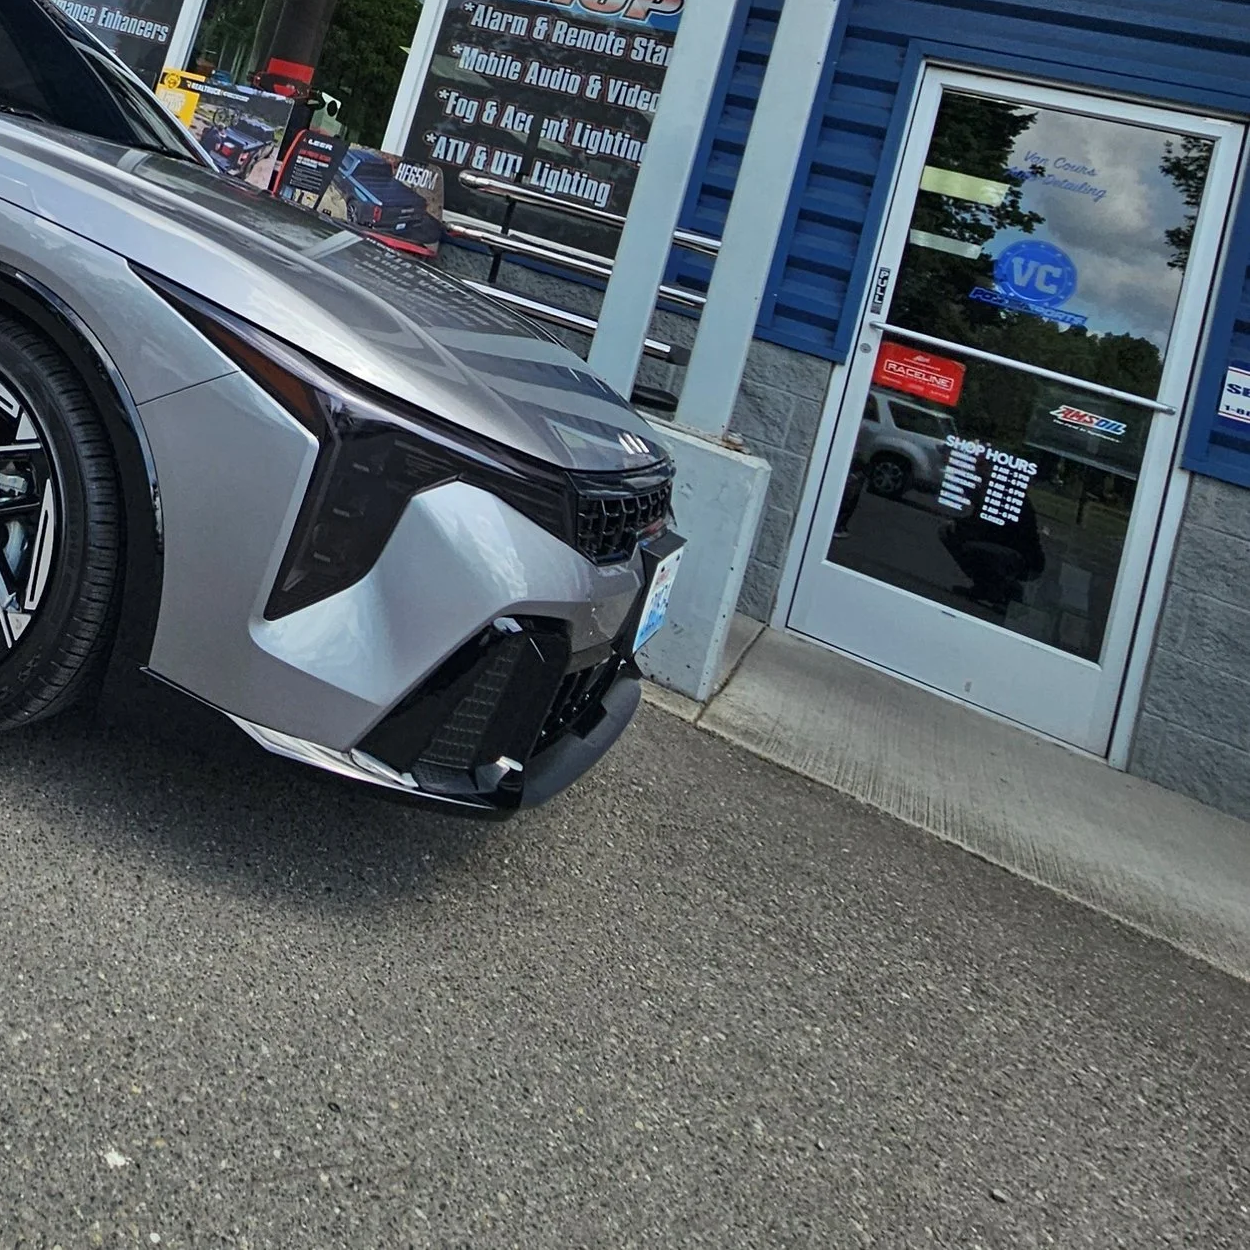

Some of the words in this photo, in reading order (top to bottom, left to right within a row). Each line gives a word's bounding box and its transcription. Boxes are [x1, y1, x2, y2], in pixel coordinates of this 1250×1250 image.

[98, 6, 170, 42] Enhancers
[532, 15, 548, 41] &
[551, 19, 627, 57] Remote
[524, 61, 582, 96] Audio
[585, 72, 602, 100] &
[607, 78, 661, 113] Video
[481, 100, 498, 126] &
[307, 138, 334, 151] LEER
[394, 162, 439, 191] HF650M
[471, 146, 488, 171] &
[530, 160, 612, 208] Lighting
[1023, 150, 1050, 165] Van
[1053, 156, 1099, 178] Cours
[1041, 174, 1107, 203] Detailing
[874, 270, 889, 304] PULL
[1012, 256, 1062, 294] VC
[969, 286, 1088, 325] POSPORTS
[887, 361, 951, 389] RACELINE
[1050, 404, 1127, 435] AMSOIL
[945, 434, 985, 456] SHOP
[985, 448, 1038, 475] HOURS
